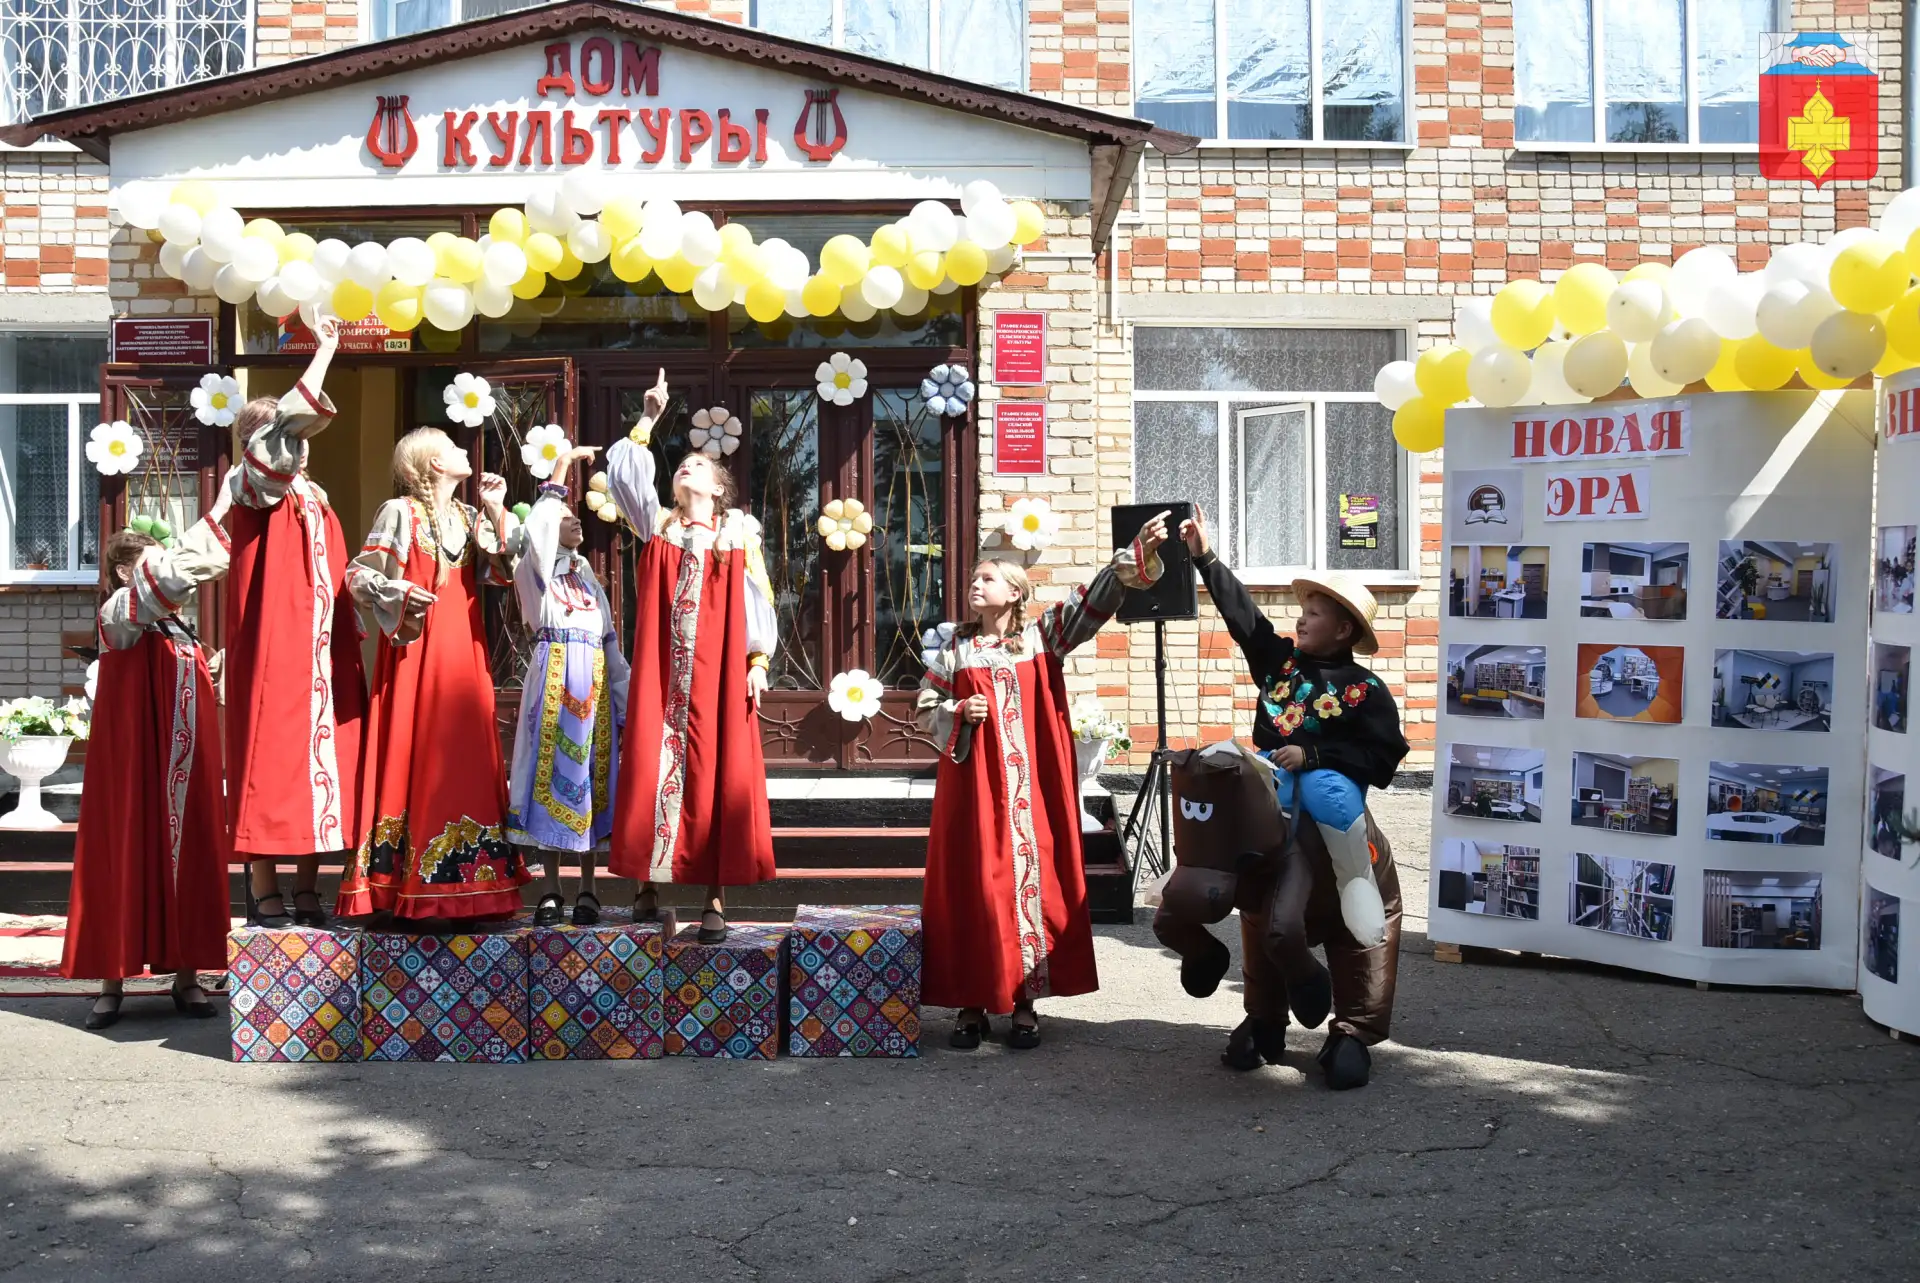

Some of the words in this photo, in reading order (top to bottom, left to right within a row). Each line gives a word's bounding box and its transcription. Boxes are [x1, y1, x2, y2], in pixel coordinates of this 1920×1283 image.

[537, 38, 661, 96] ДОМ
[443, 107, 769, 167] КУЛЬТУРЫ
[338, 328, 391, 336] ОМИССИЯ
[343, 342, 373, 350] УЧАСТКА
[385, 341, 408, 349] 18/31
[1511, 410, 1684, 458] НОВАЯ
[1547, 472, 1642, 516] ЭРА
